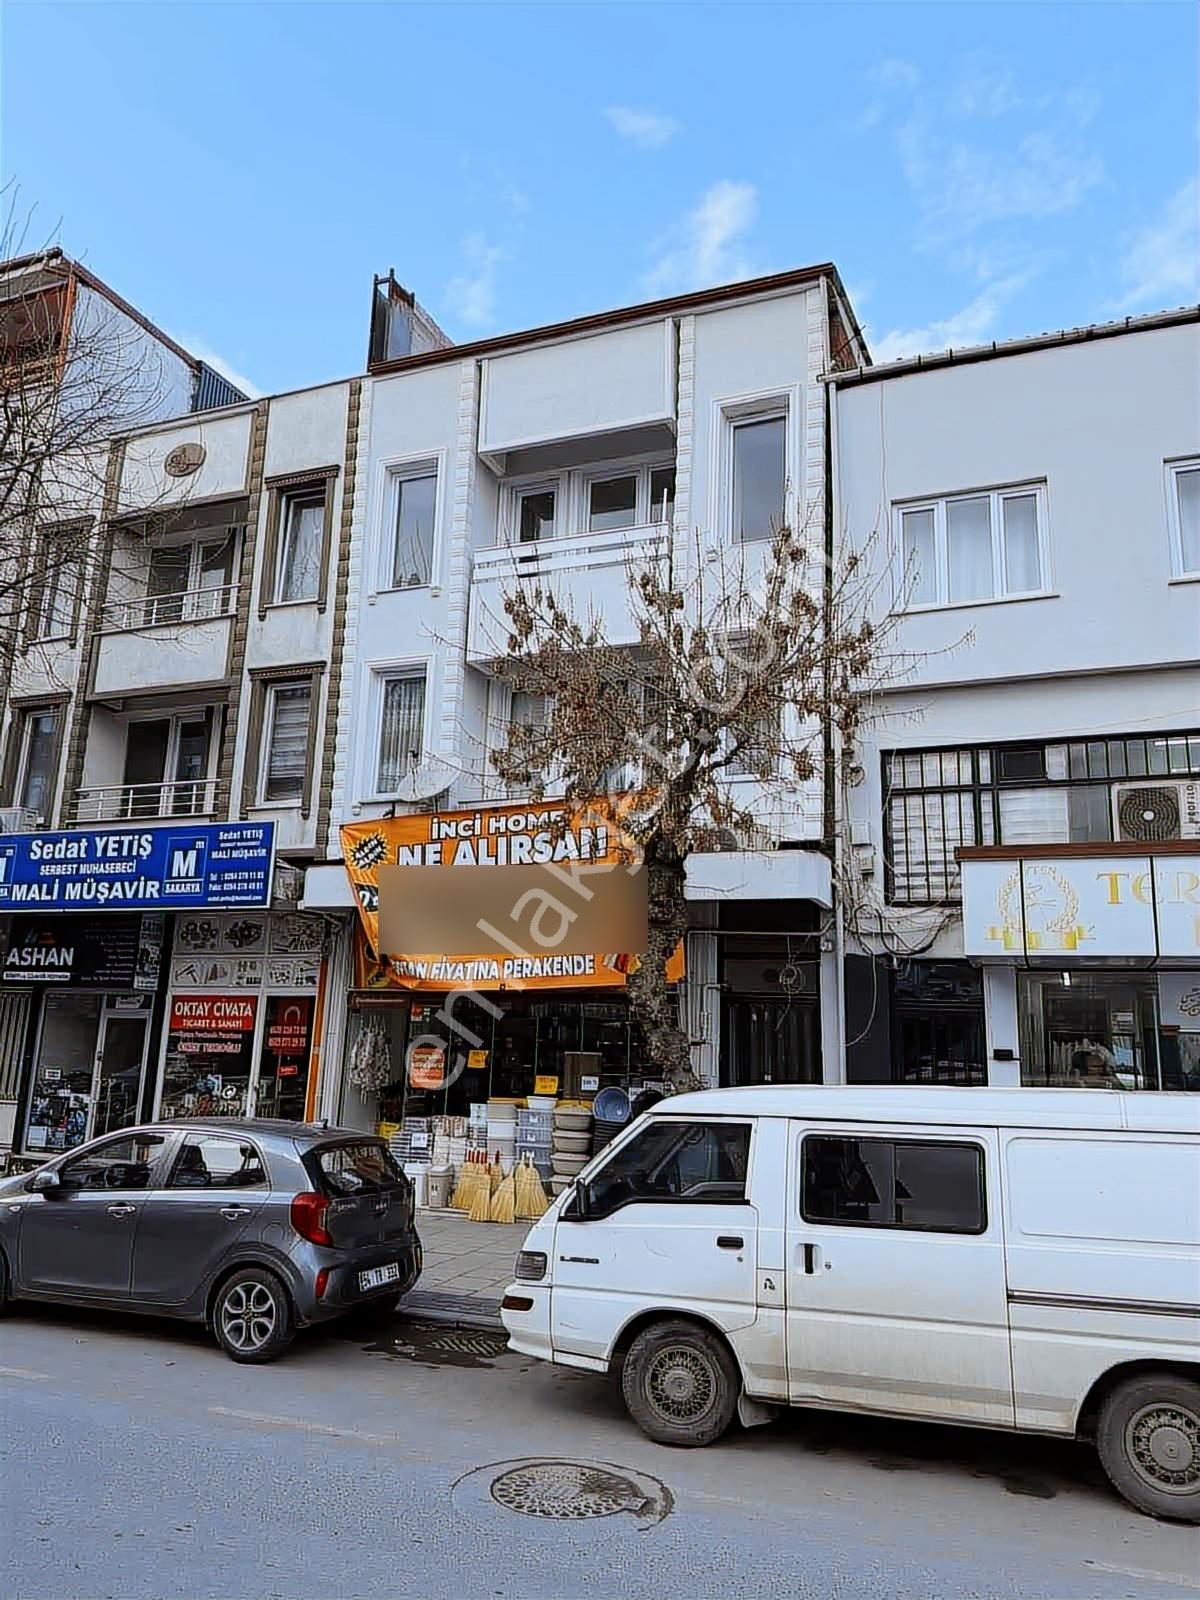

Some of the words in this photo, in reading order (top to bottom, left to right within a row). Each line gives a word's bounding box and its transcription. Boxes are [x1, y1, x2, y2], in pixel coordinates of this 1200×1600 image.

[30, 838, 88, 860] Sedat
[398, 843, 442, 866] NE
[452, 826, 608, 866] ALIRSAN
[40, 864, 78, 876] SERBEST
[79, 859, 137, 875] MUHASEBECİ
[172, 849, 197, 877] M
[12, 878, 59, 901] MALİ
[65, 876, 160, 904] MÜŞAVİR
[165, 882, 200, 894] SAKARYA
[6, 947, 74, 966] ASHAN
[503, 954, 595, 979] PERAKENDE
[175, 1001, 212, 1017] OKTAY
[213, 998, 253, 1017] CİVATA
